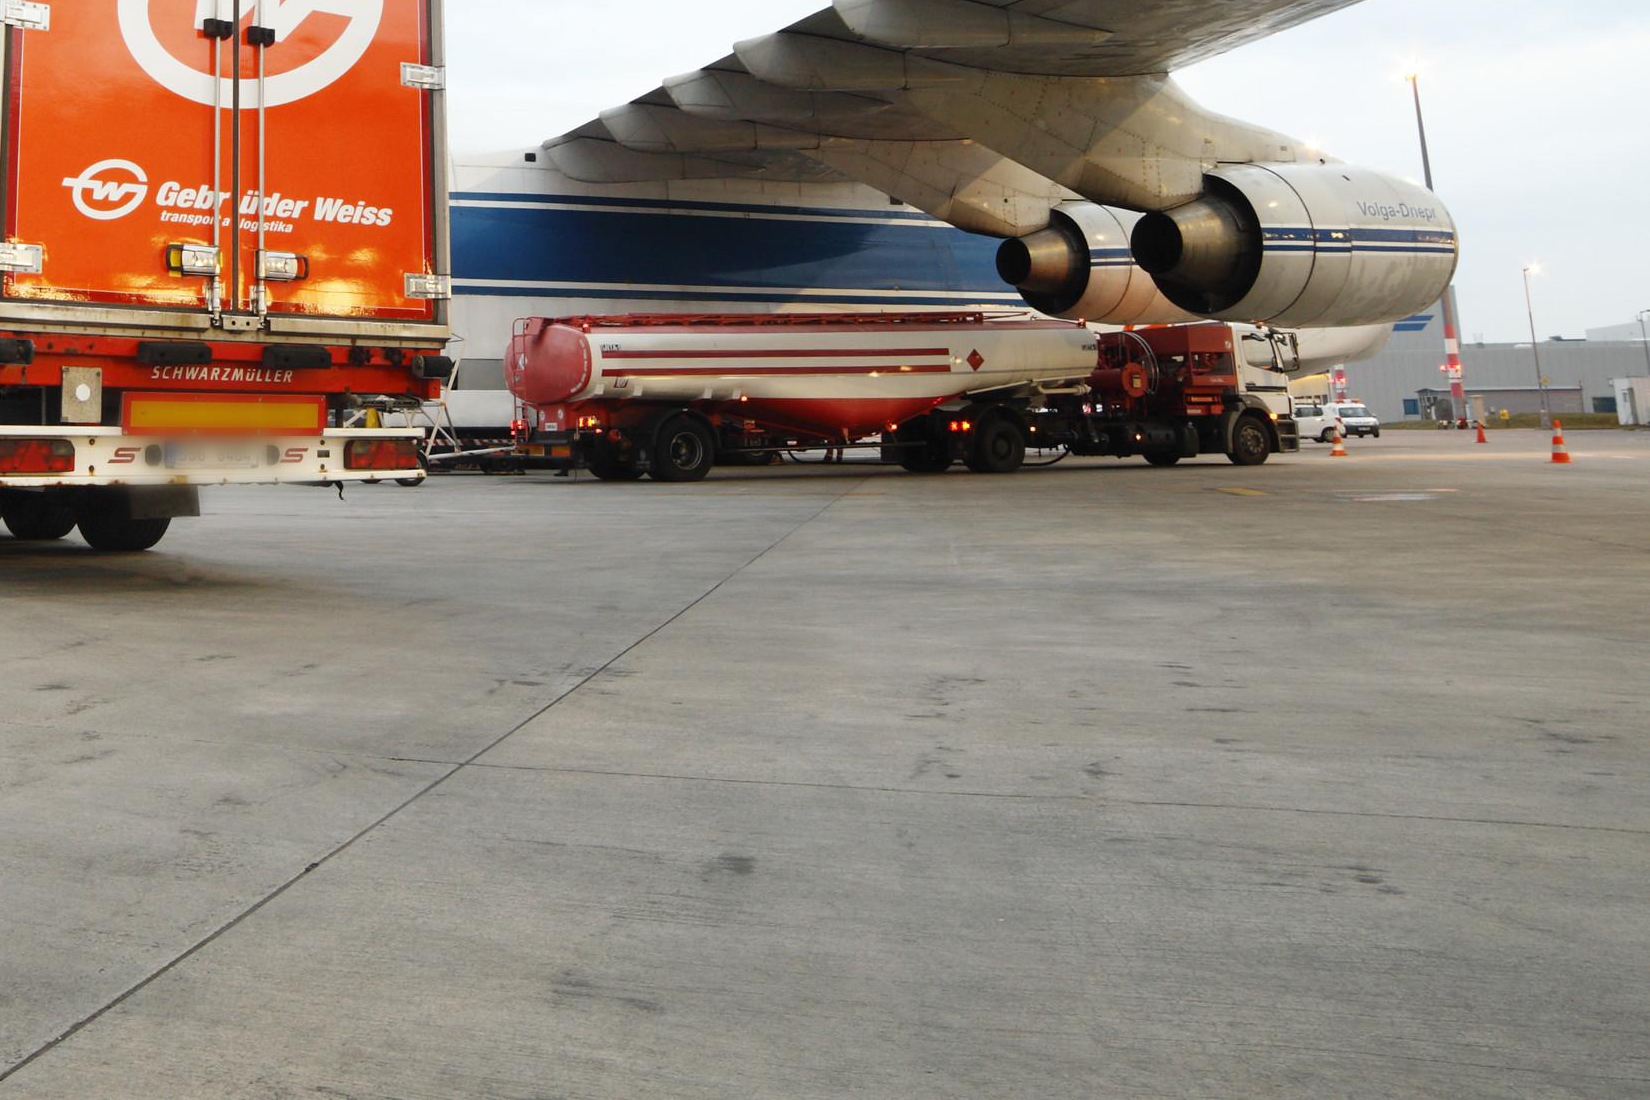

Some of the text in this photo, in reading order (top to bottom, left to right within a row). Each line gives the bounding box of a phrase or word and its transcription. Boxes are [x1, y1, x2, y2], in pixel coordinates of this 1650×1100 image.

[313, 197, 393, 227] Weiss
[1356, 201, 1437, 221] Volga-Dnepr
[221, 216, 231, 227] a
[239, 218, 293, 233] logstika
